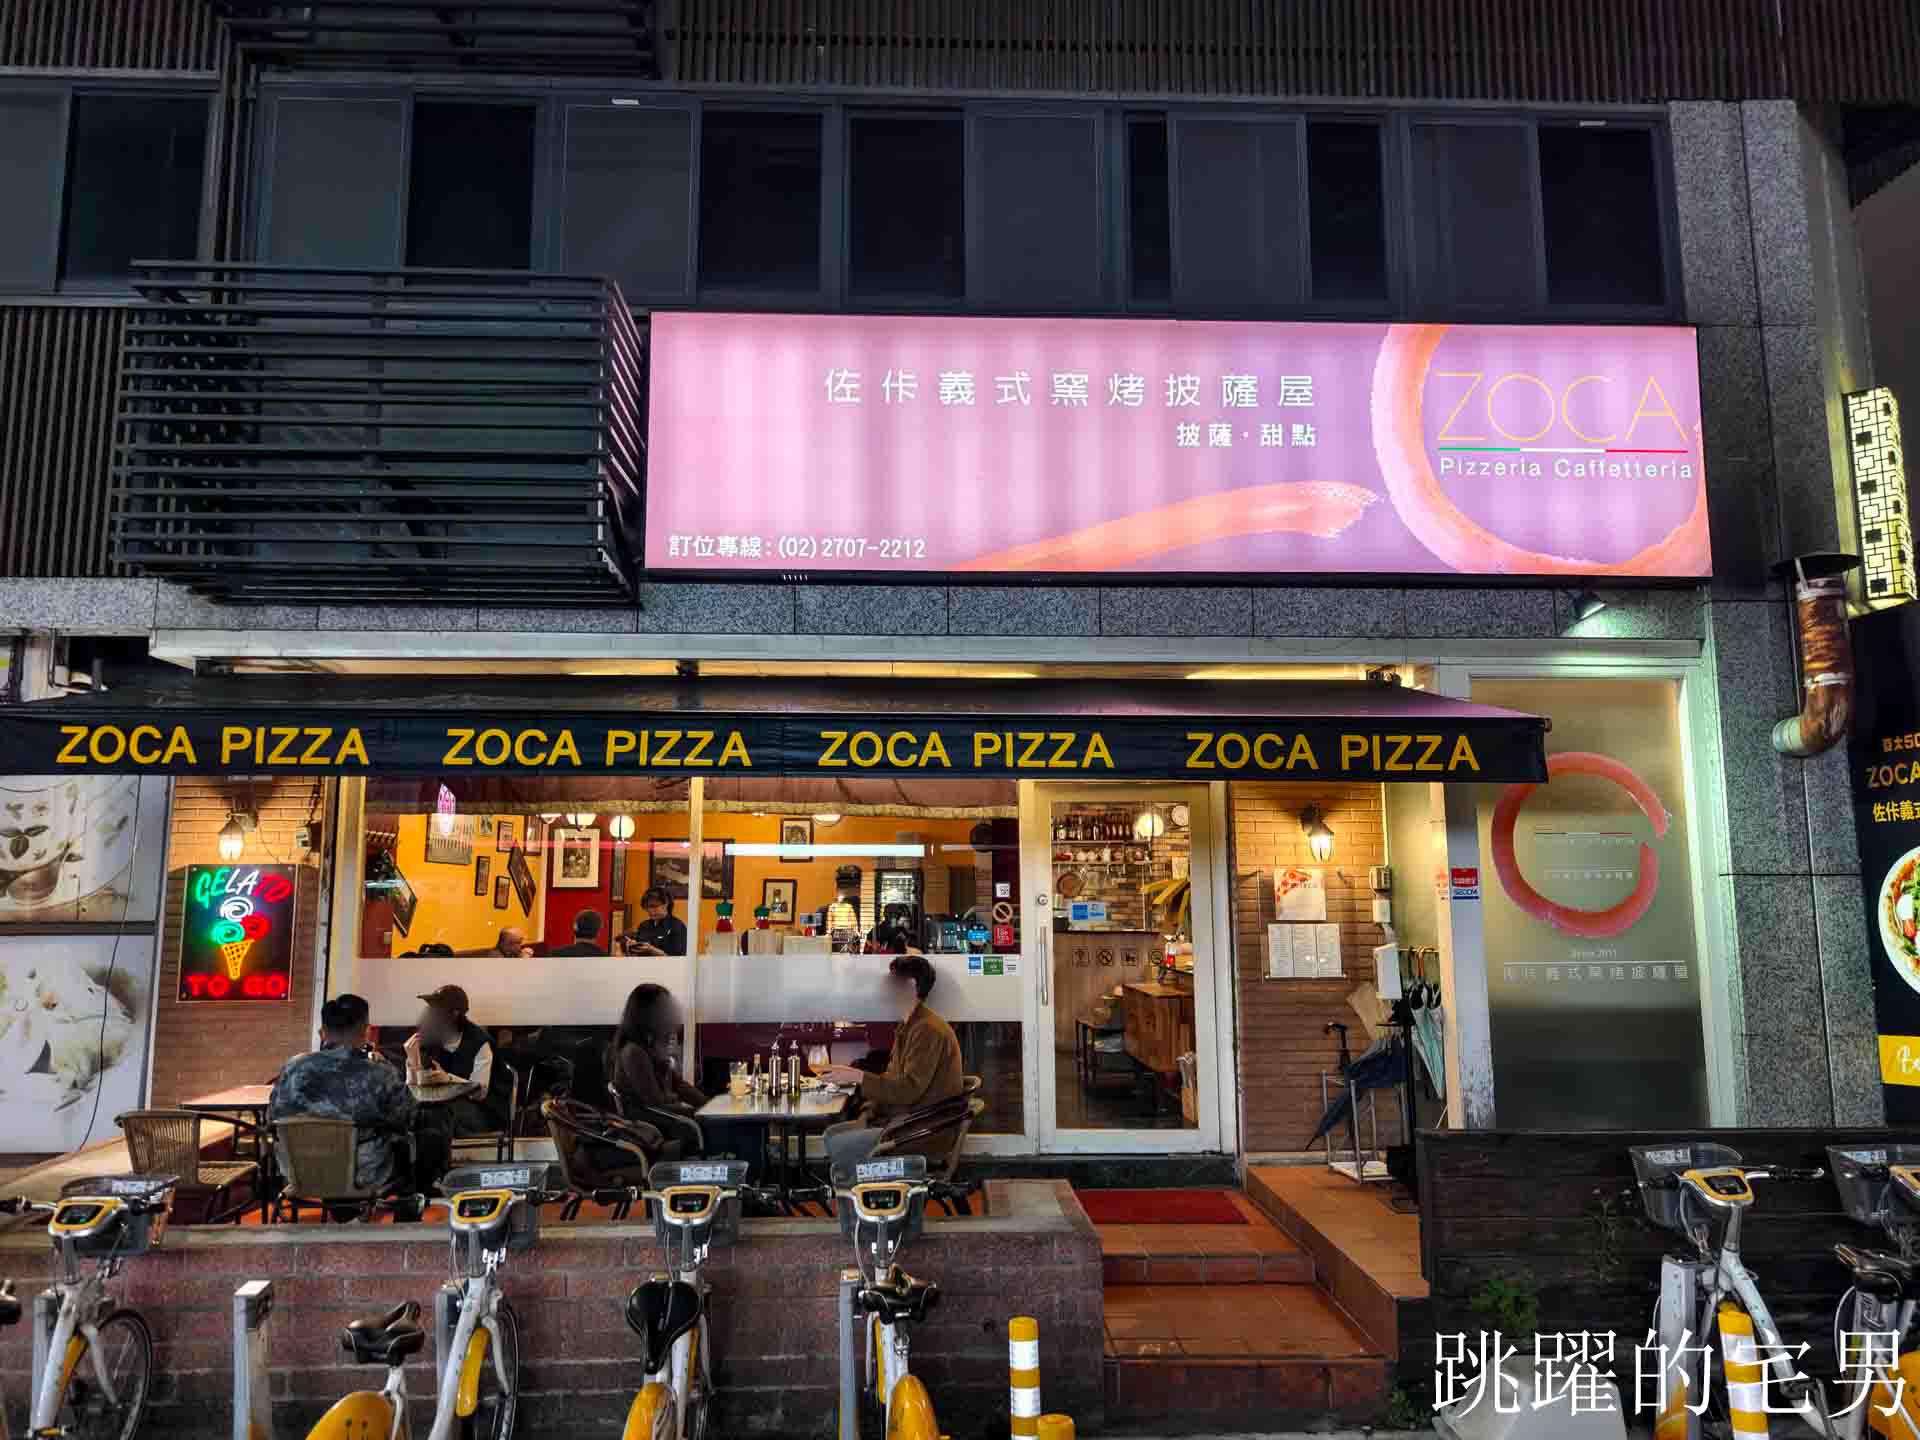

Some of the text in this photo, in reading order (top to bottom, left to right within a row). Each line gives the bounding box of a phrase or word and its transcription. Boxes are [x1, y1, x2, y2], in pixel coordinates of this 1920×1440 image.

[1437, 371, 1689, 443] ZOCA
[1440, 457, 1692, 480] Pizzeria Caffetteria
[55, 725, 369, 765] ZOCA PIZZA
[441, 728, 753, 767] ZOCA PIZZA
[817, 730, 1115, 769] ZOCA PIZZA
[1186, 732, 1481, 771] ZOCA PIZZA
[195, 866, 293, 908] GELATO
[187, 972, 288, 998] TO GO
